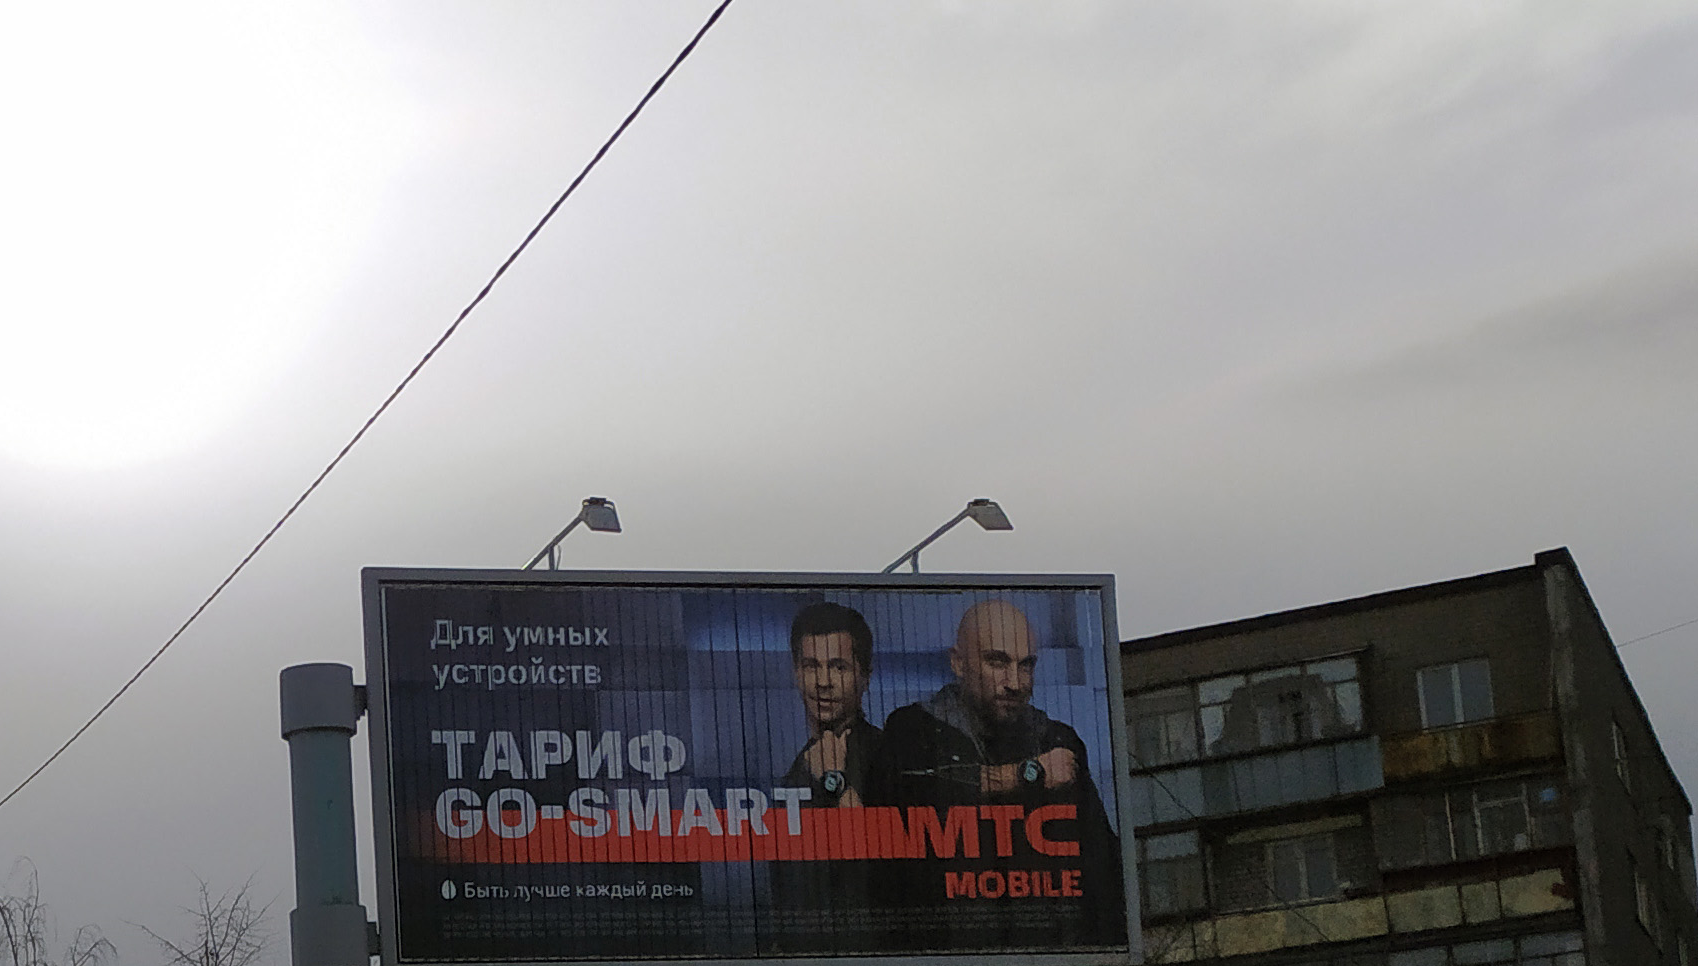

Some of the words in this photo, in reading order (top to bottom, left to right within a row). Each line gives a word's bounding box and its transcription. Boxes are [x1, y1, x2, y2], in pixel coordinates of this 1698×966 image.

[430, 618, 494, 650] Для
[502, 625, 610, 652] умных
[432, 656, 602, 690] устройств
[431, 729, 687, 781] ТАРИФ
[434, 786, 813, 839] GO-SMART
[907, 804, 1081, 858] МТС
[463, 881, 510, 899] Быть
[513, 885, 571, 902] лучше
[575, 880, 646, 900] каждый
[650, 884, 694, 900] день
[945, 869, 1084, 899] MOBILE
